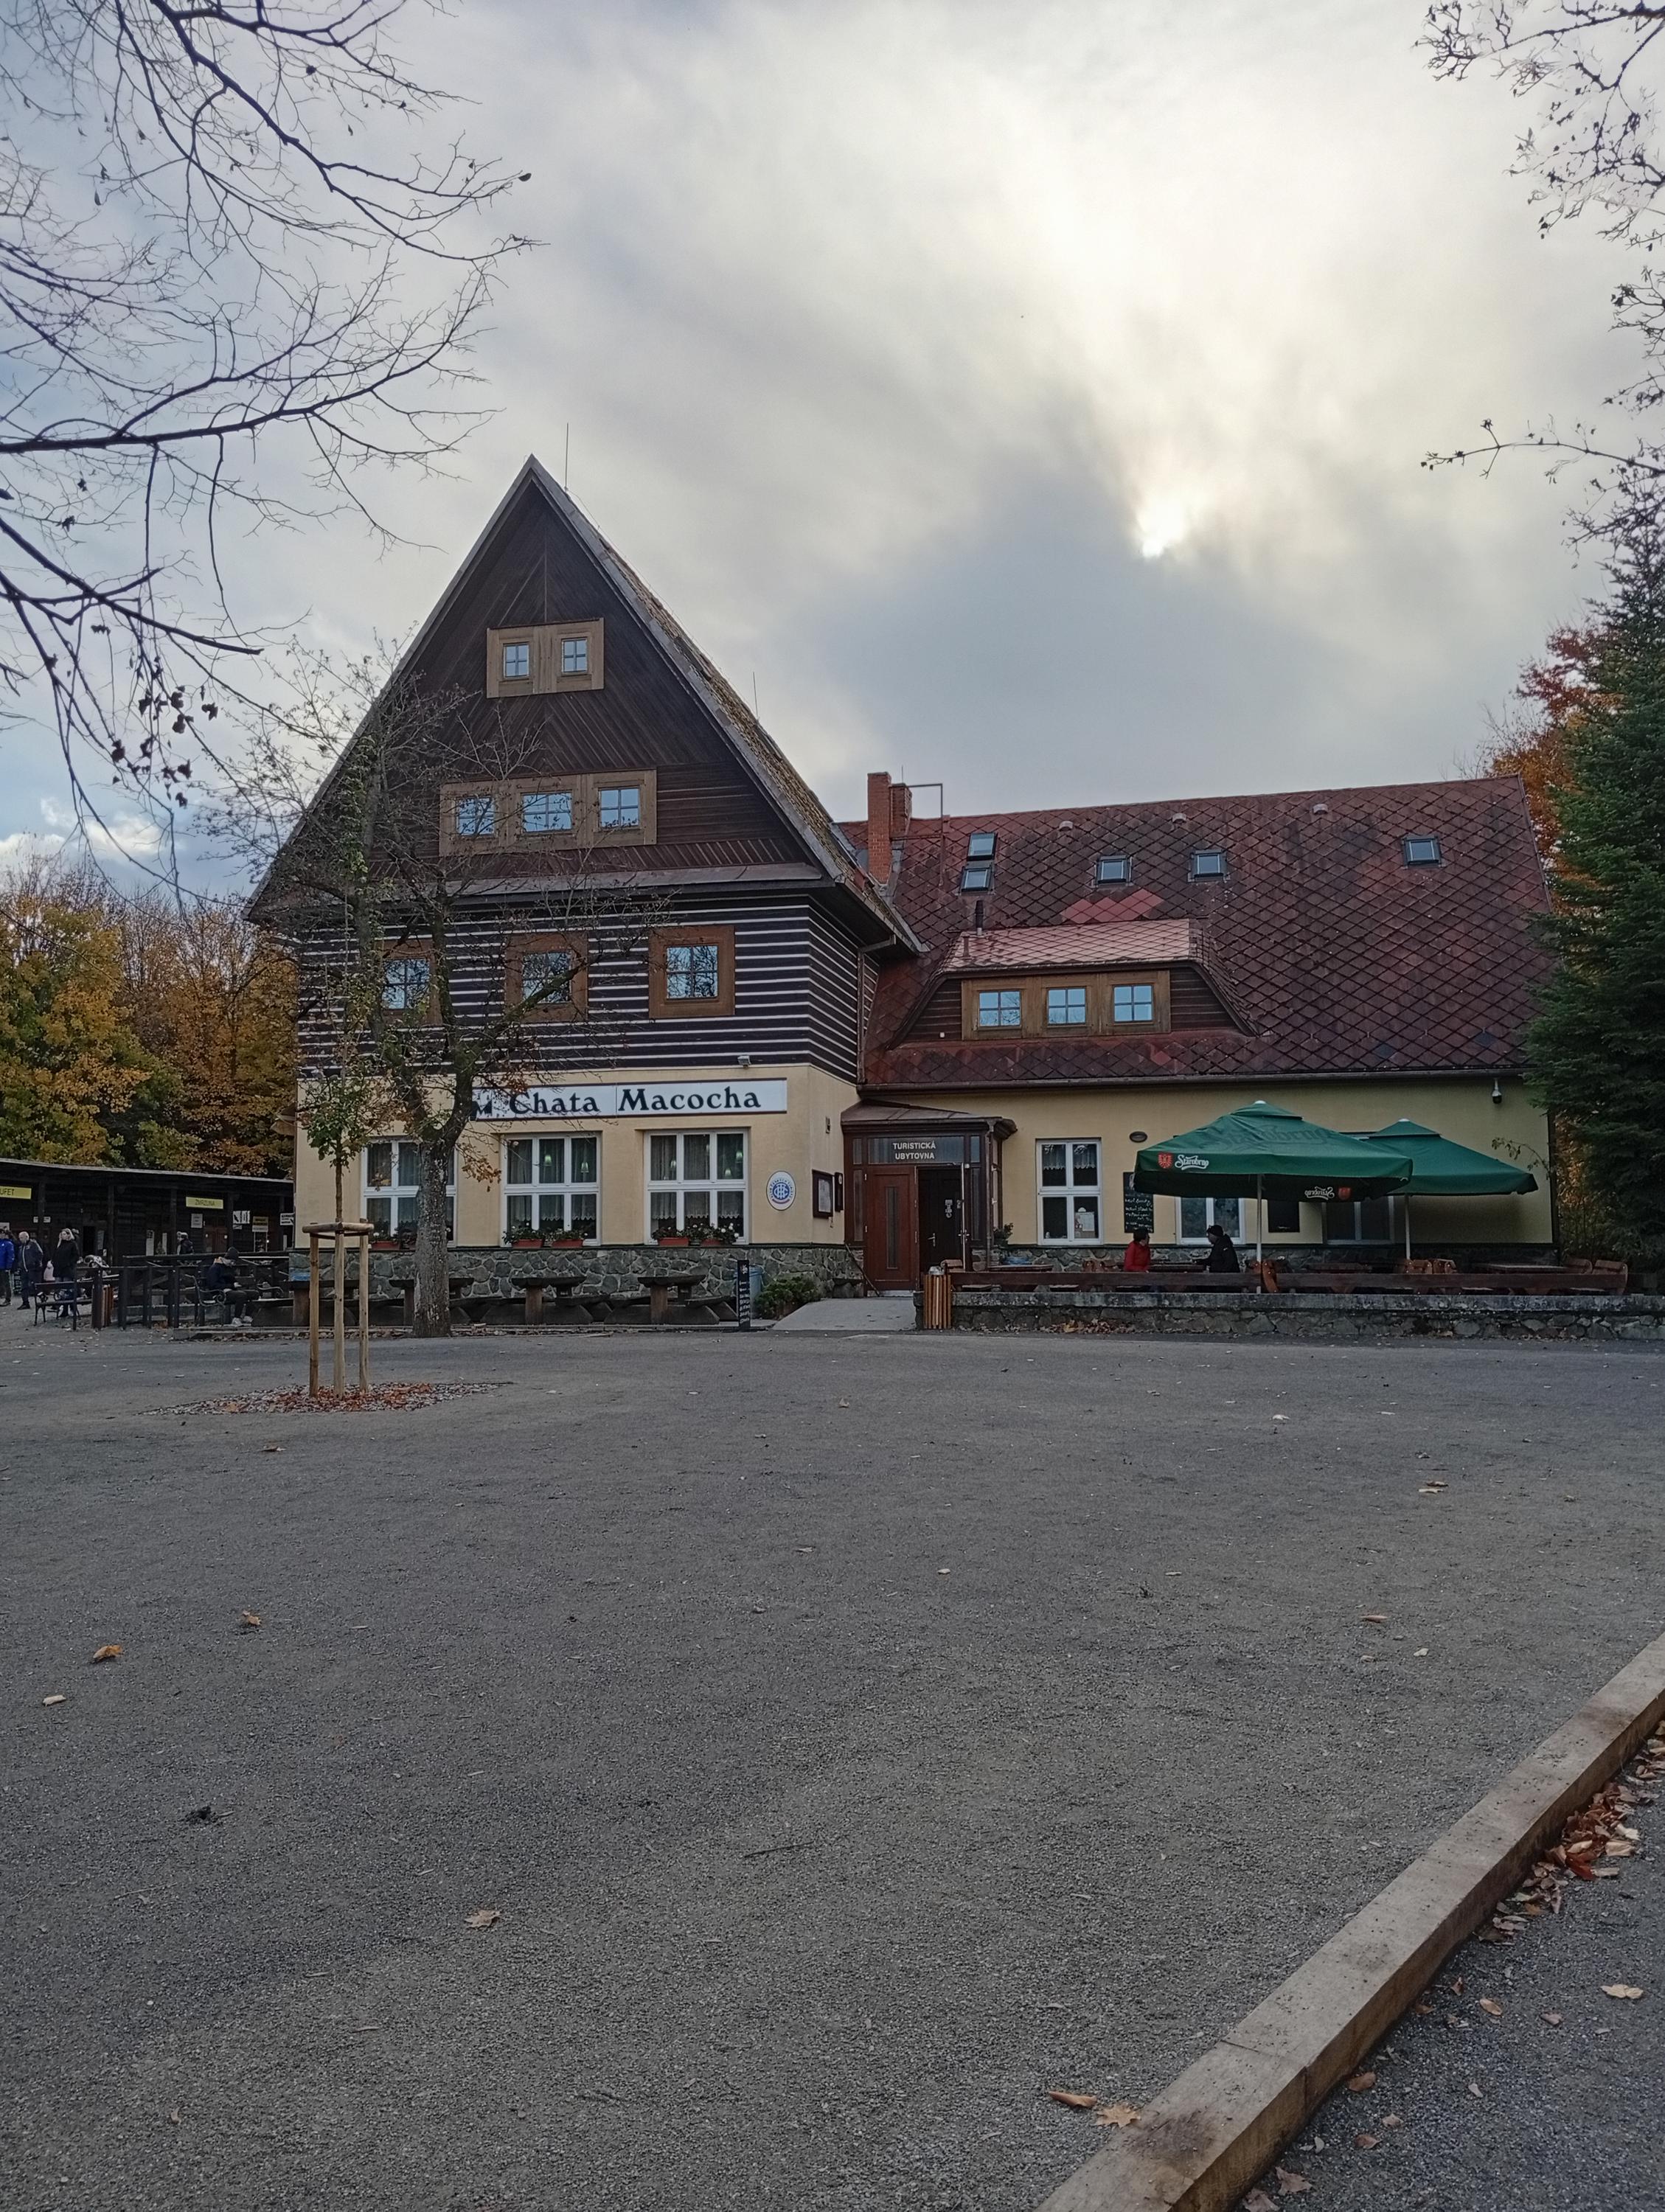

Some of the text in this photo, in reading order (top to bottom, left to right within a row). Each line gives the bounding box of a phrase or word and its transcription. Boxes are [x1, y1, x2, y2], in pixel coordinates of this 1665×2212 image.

[509, 1086, 762, 1115] Chata Macocha
[892, 1140, 936, 1150] TURISTICKÁ
[1174, 1154, 1210, 1171] Starobrno
[0, 1187, 15, 1196] UFET
